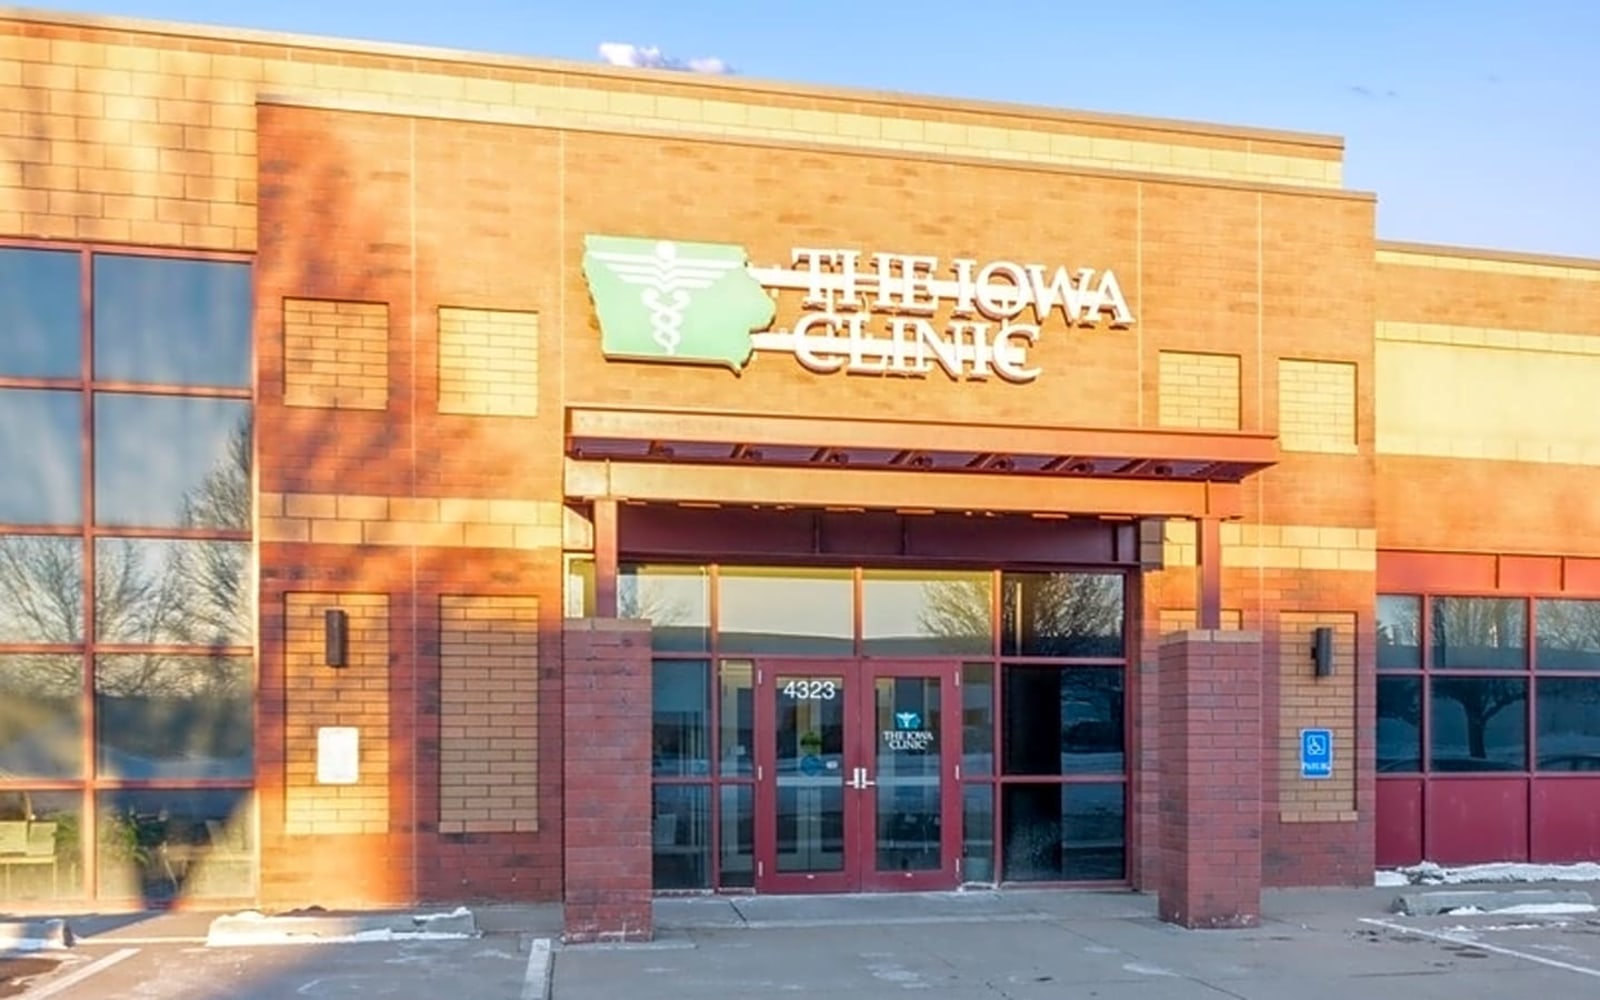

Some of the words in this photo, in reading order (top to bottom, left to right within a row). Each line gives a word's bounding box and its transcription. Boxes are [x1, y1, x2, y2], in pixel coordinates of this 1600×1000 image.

[792, 248, 938, 314] THE
[952, 257, 1136, 328] IOWA
[794, 313, 1042, 383] CLINIC
[783, 680, 836, 700] 4323
[883, 731, 906, 741] THE
[907, 731, 934, 741] IOWA
[889, 740, 928, 750] CLINIC
